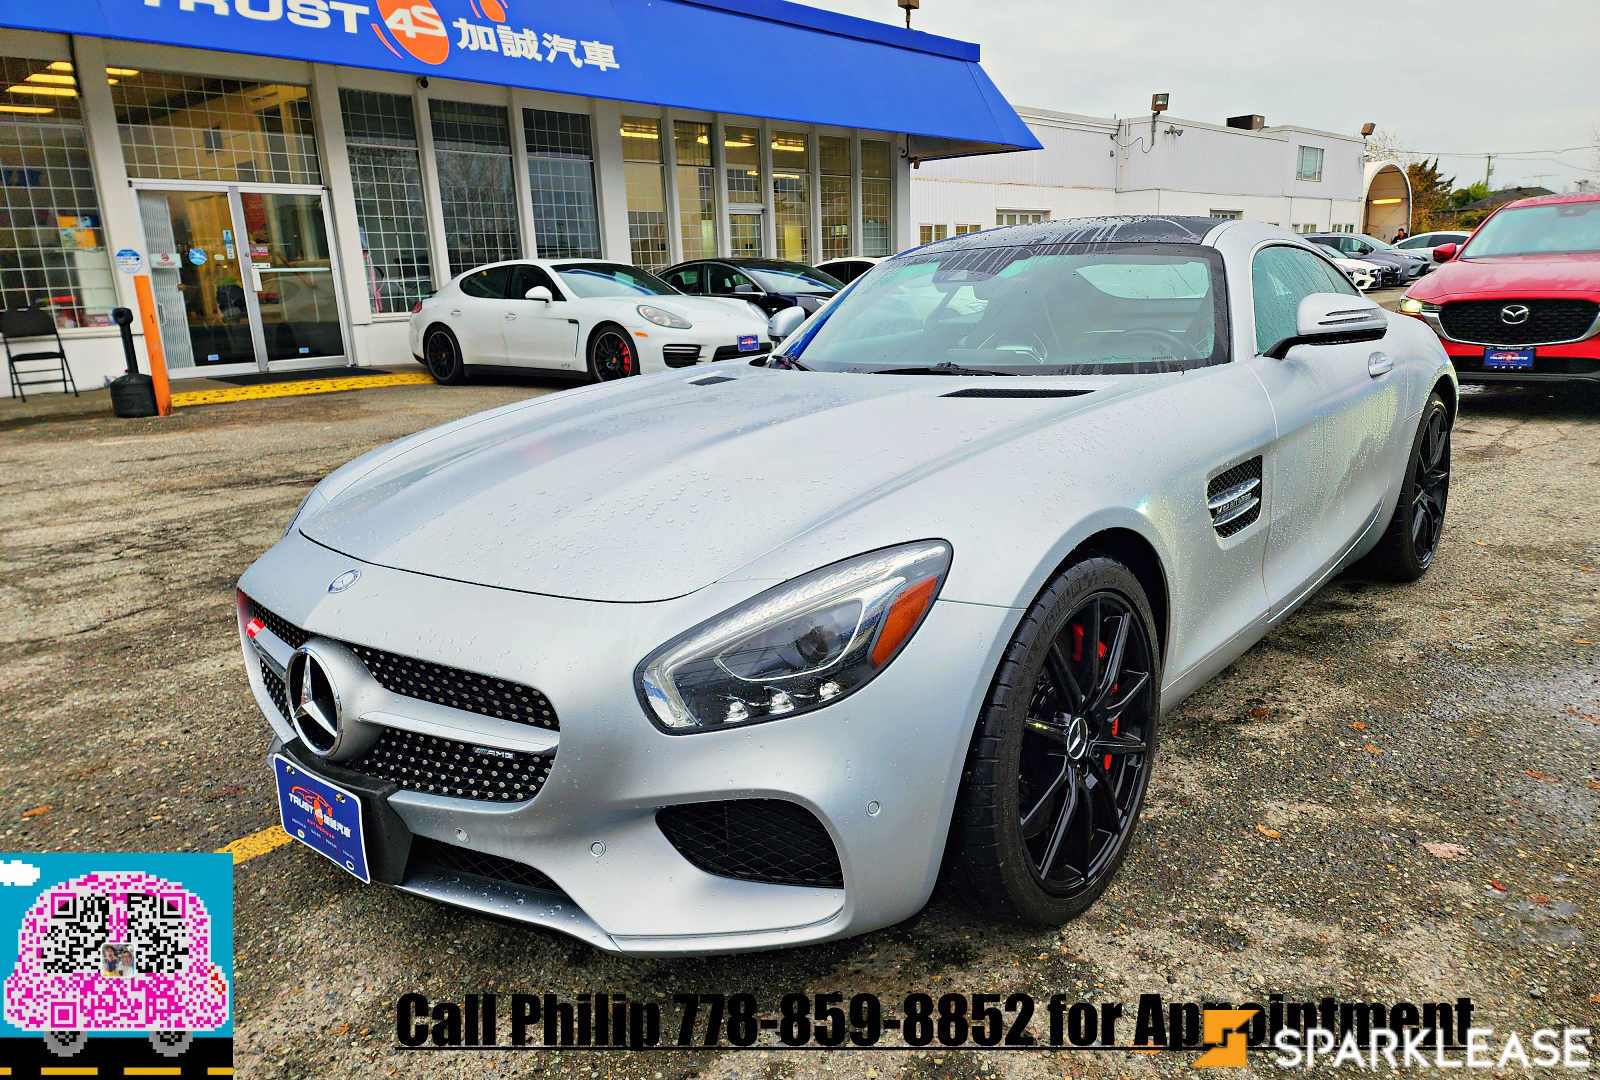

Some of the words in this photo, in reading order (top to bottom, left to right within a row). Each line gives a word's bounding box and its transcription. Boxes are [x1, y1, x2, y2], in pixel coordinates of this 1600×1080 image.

[385, 5, 447, 39] 4S
[452, 17, 620, 72] 加誠汽車
